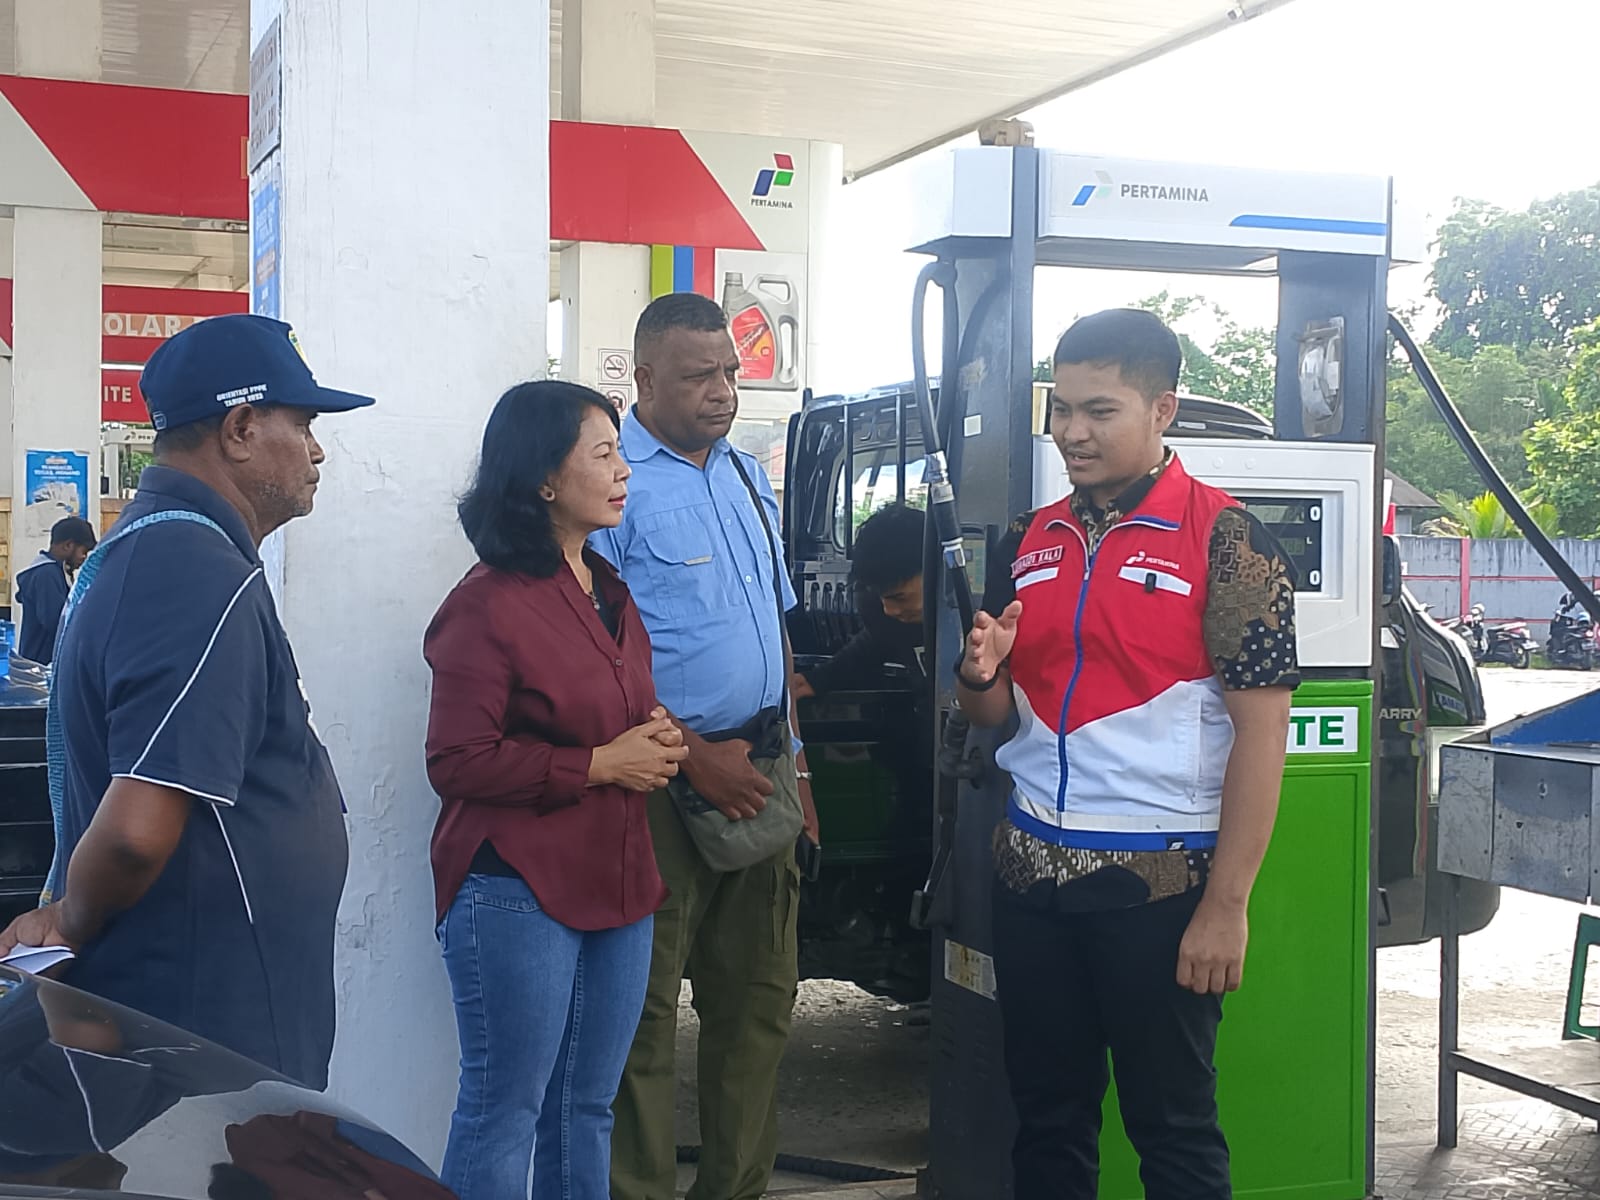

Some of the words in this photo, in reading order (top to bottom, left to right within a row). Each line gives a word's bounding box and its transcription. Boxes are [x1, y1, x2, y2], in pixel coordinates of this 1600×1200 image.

[1121, 184, 1209, 202] PERTAMINA
[751, 199, 793, 208] PERTAMINA
[1310, 506, 1321, 521] 0
[1310, 570, 1320, 585] 0
[1290, 715, 1344, 746] TE
